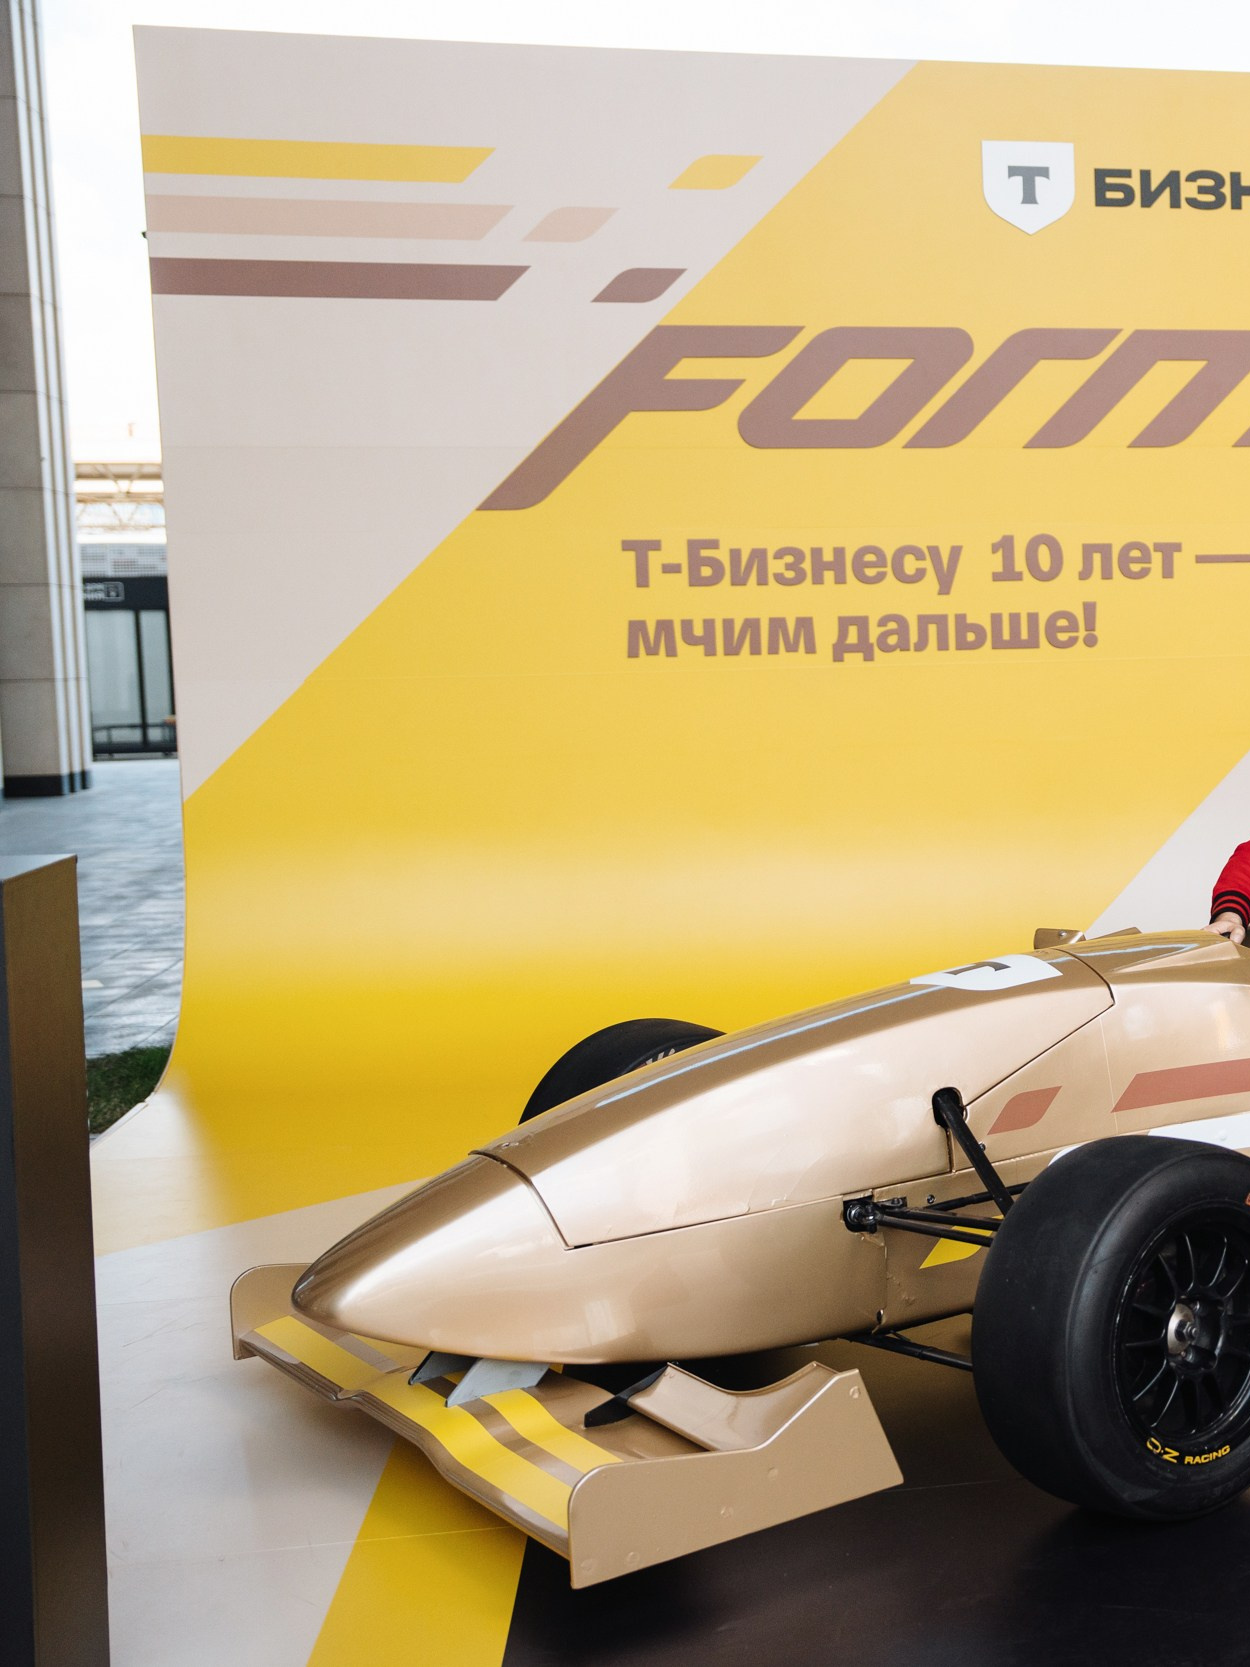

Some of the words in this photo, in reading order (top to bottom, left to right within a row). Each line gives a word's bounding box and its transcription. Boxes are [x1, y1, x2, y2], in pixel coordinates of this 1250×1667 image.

[1007, 165, 1051, 205] Т
[621, 538, 964, 595] Т-Бизнесу
[991, 533, 1064, 582] 10
[1078, 540, 1183, 580] лет
[627, 616, 817, 658] мчим
[832, 601, 1099, 662] дальше!
[1184, 1445, 1231, 1465] RACING
